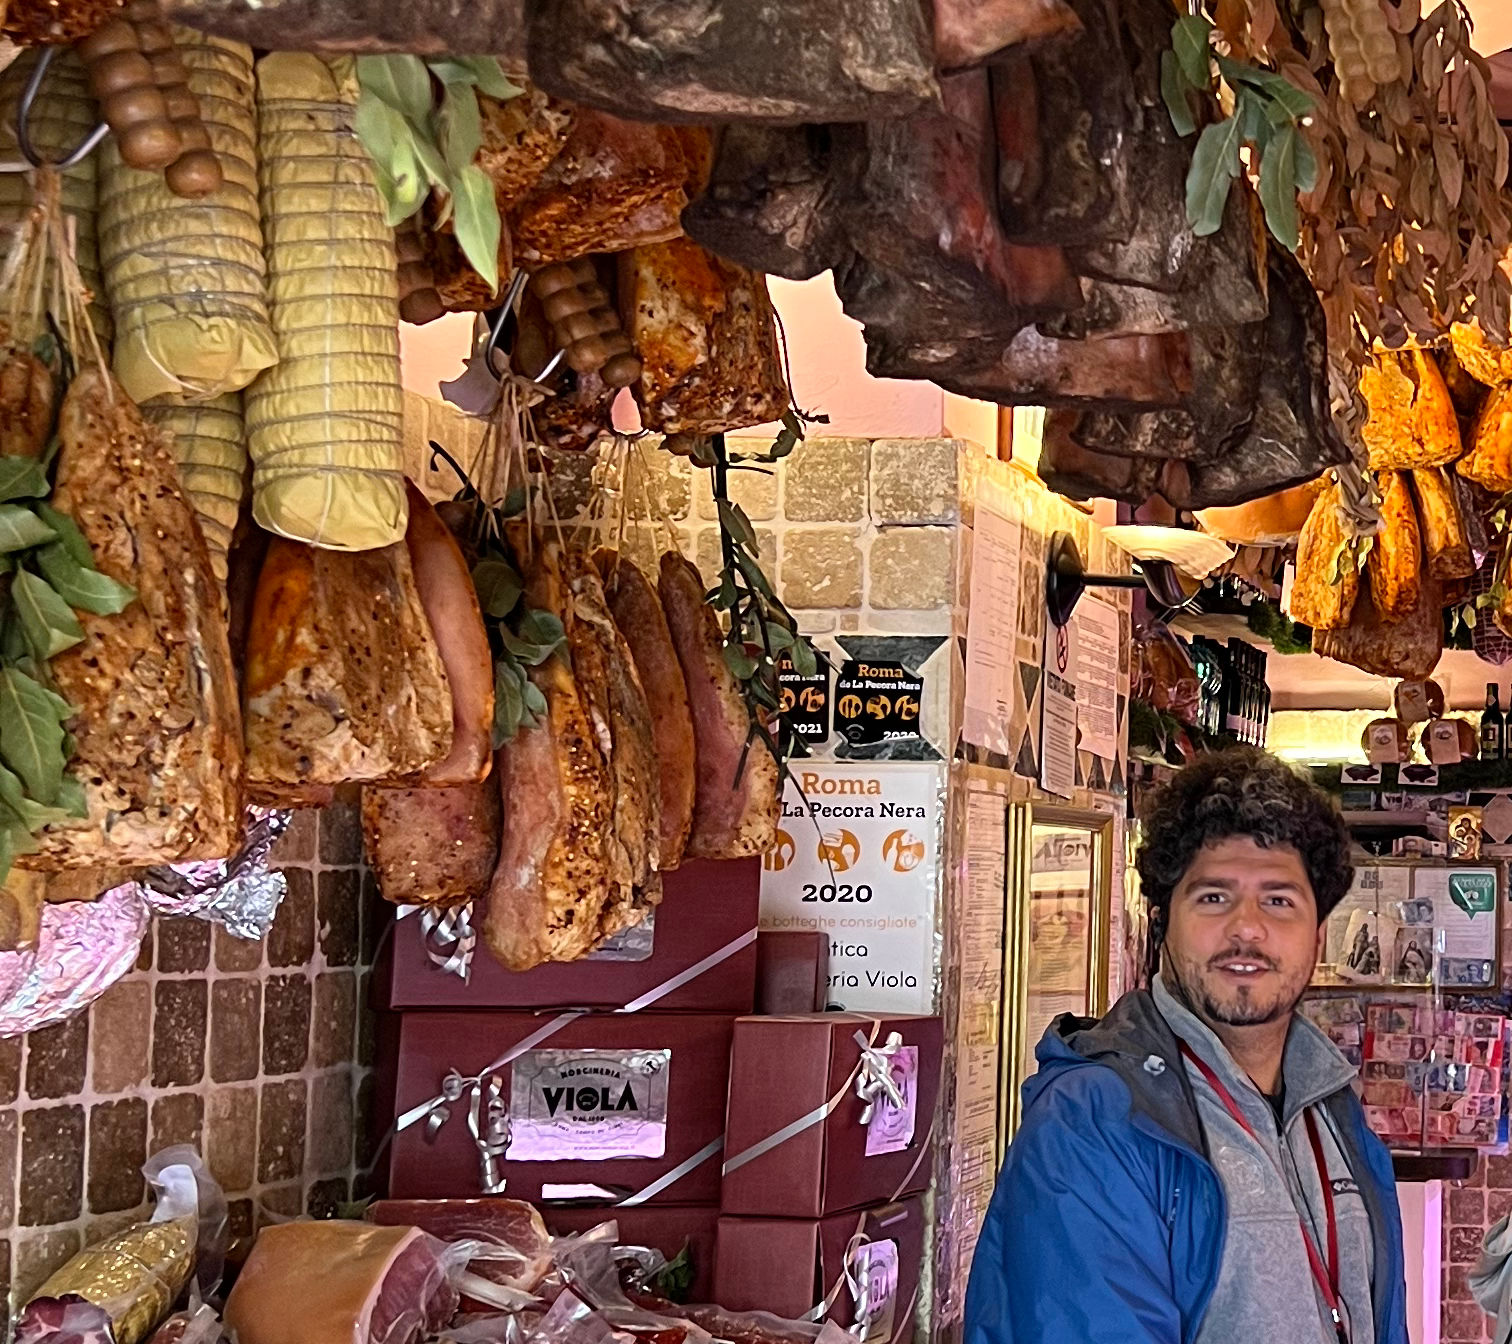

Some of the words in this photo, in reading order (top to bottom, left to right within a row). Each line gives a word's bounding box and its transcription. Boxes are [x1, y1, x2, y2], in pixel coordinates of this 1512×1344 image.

[858, 664, 903, 678] Roma
[852, 680, 863, 689] La
[865, 681, 896, 689] Pecora
[897, 681, 920, 690] Nera
[793, 723, 822, 734] 021
[801, 772, 882, 795] Roma
[781, 802, 804, 818] La
[809, 802, 874, 818] Pecora
[879, 803, 926, 818] Nera
[801, 884, 873, 902] 2020
[772, 915, 836, 930] botteghe
[840, 915, 917, 931] consigliate
[828, 941, 868, 957] tica
[865, 970, 917, 988] Viola
[542, 1080, 639, 1118] VIOLA
